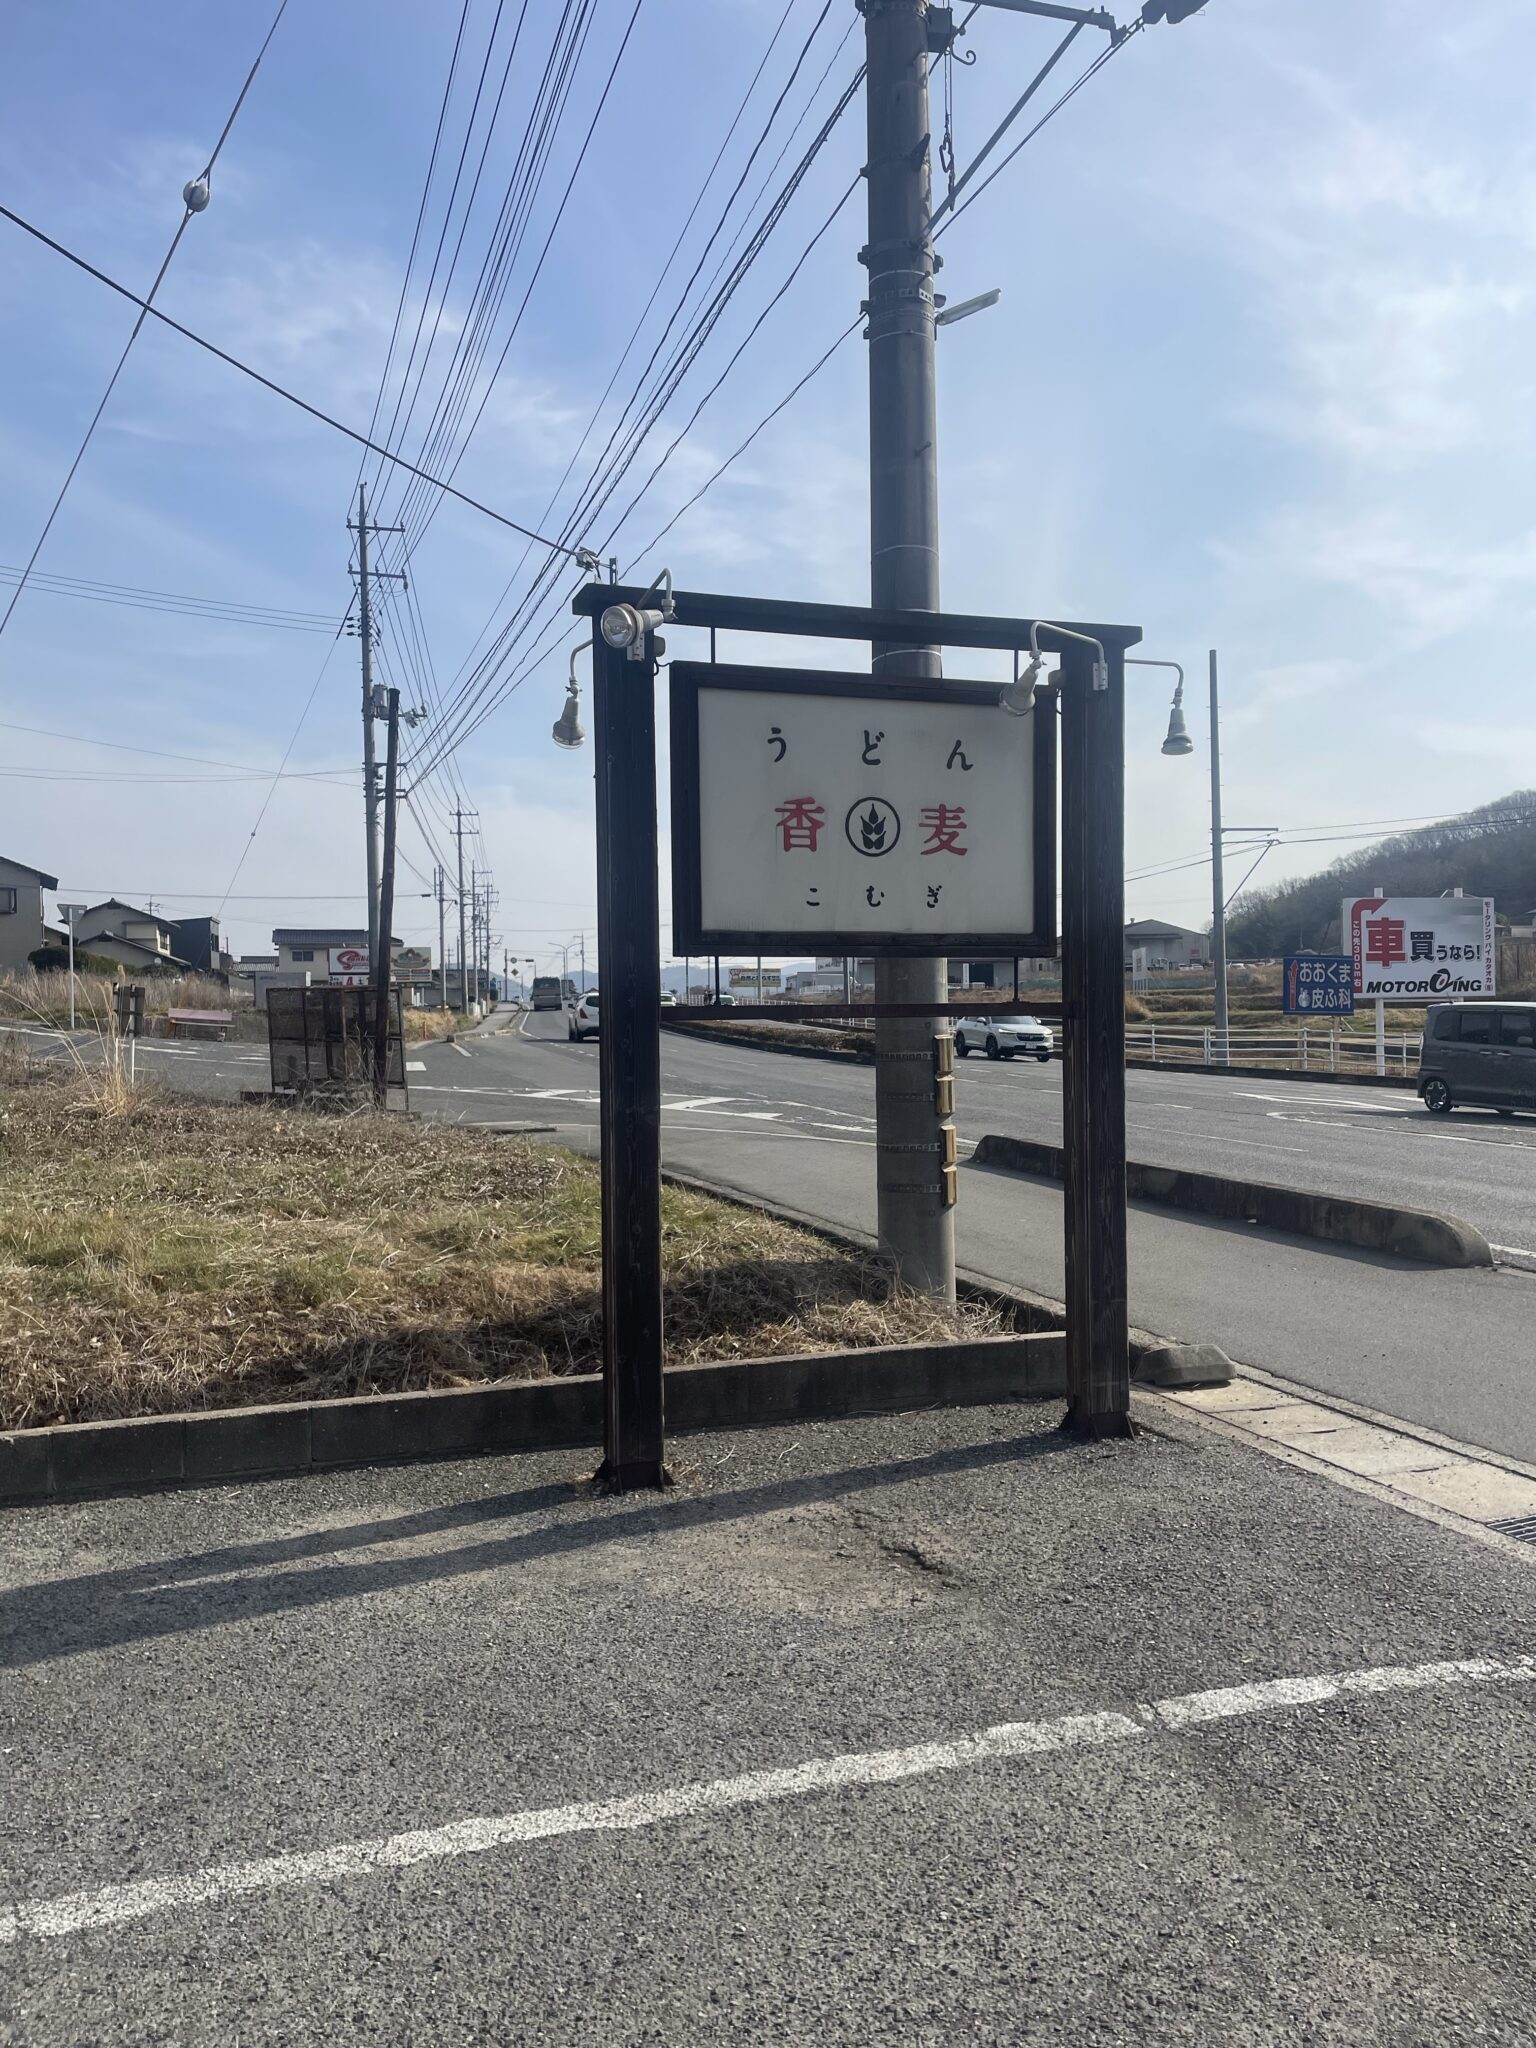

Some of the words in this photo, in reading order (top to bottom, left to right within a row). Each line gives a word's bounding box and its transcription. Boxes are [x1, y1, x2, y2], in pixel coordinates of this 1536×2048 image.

[767, 727, 974, 772] うどん
[774, 796, 969, 857] 香麦
[806, 885, 943, 909] こむぎ
[1299, 962, 1351, 983] おおくま
[1311, 988, 1351, 1009] 皮ふ科
